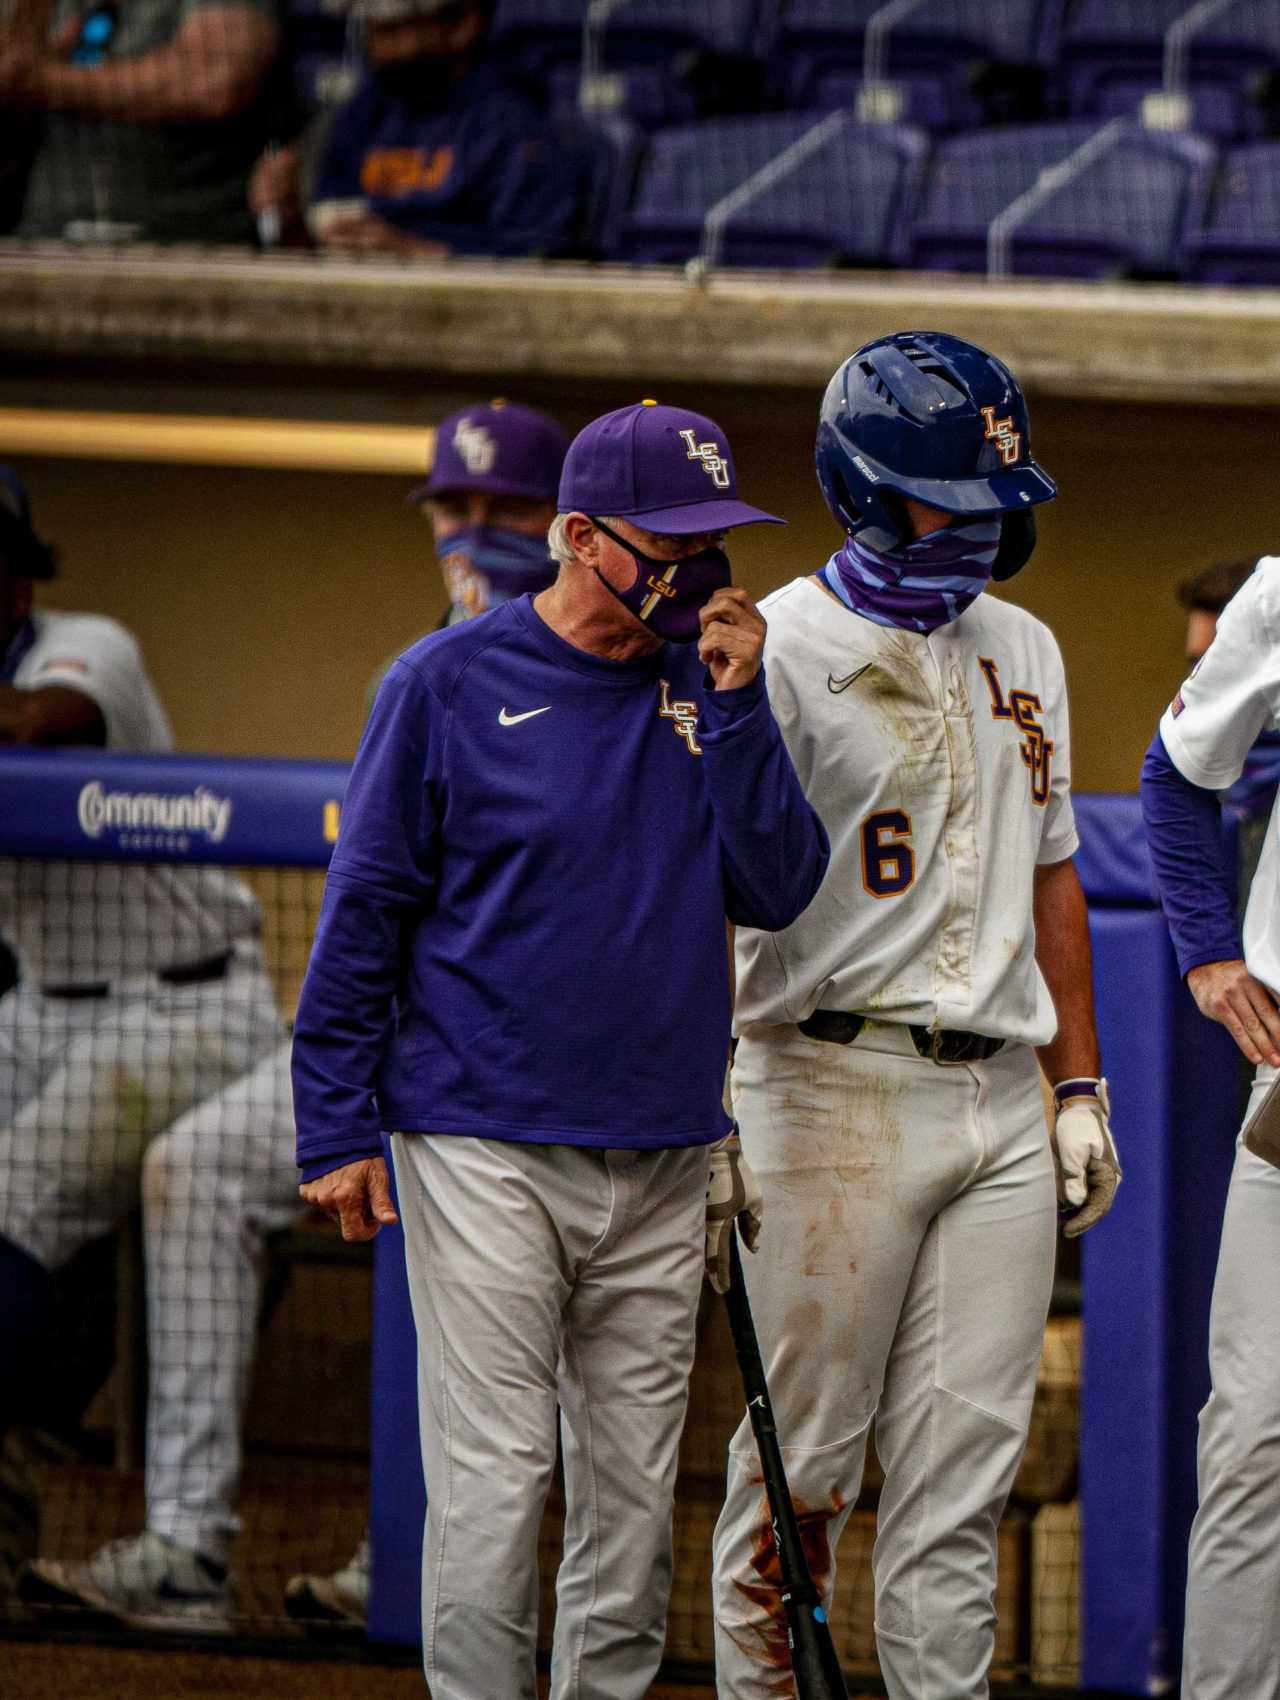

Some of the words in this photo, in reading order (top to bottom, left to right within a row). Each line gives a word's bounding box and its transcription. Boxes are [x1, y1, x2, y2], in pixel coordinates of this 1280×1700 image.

[678, 429, 730, 489] LSU
[981, 406, 1022, 466] LSU
[851, 455, 880, 483] marucci
[646, 575, 679, 599] LSU
[976, 655, 1055, 808] LSU
[78, 780, 232, 843] Community
[860, 808, 916, 899] 6
